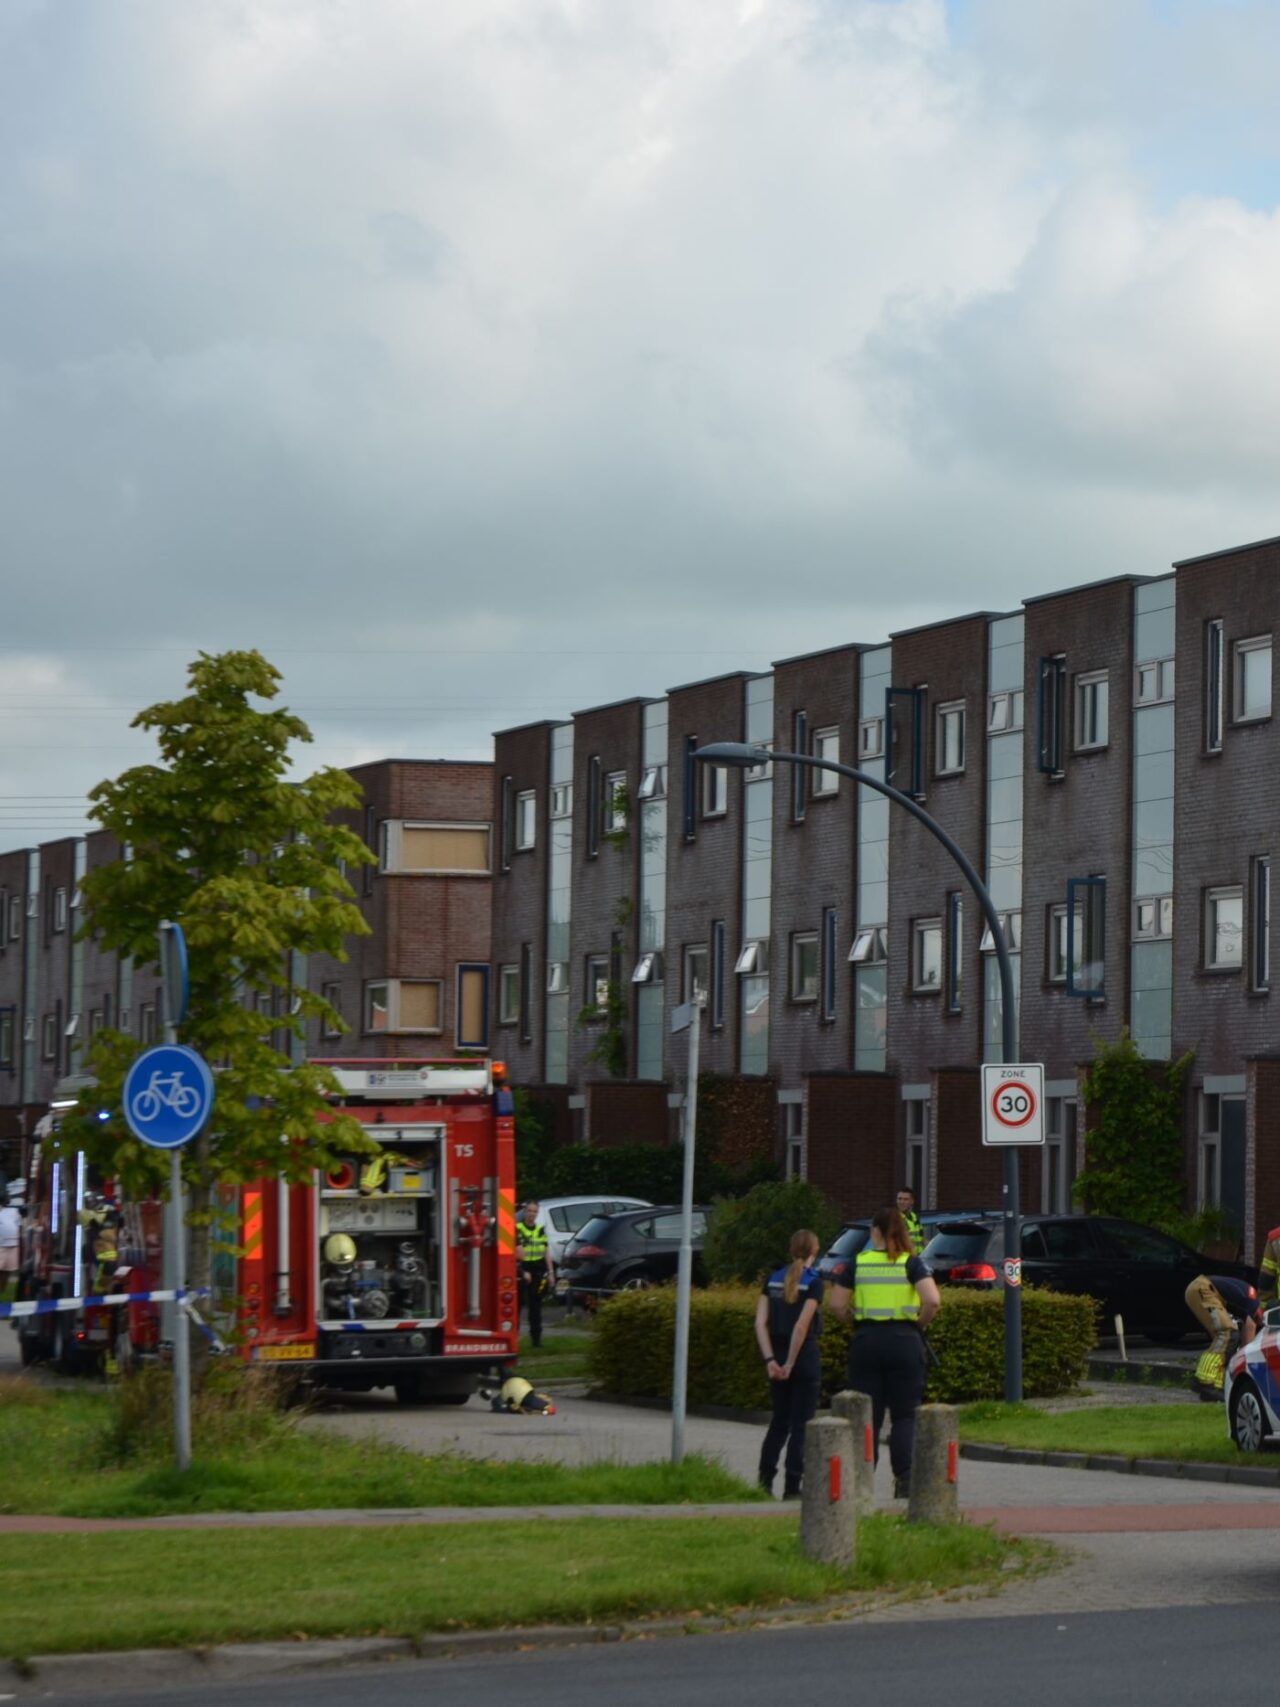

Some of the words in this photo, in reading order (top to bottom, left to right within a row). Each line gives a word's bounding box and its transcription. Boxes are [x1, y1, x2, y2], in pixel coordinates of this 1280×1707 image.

[1000, 1070, 1026, 1078] ZONE
[1000, 1095, 1028, 1113] 30
[454, 1144, 474, 1157] TS
[445, 1344, 508, 1353] BRANDWEER
